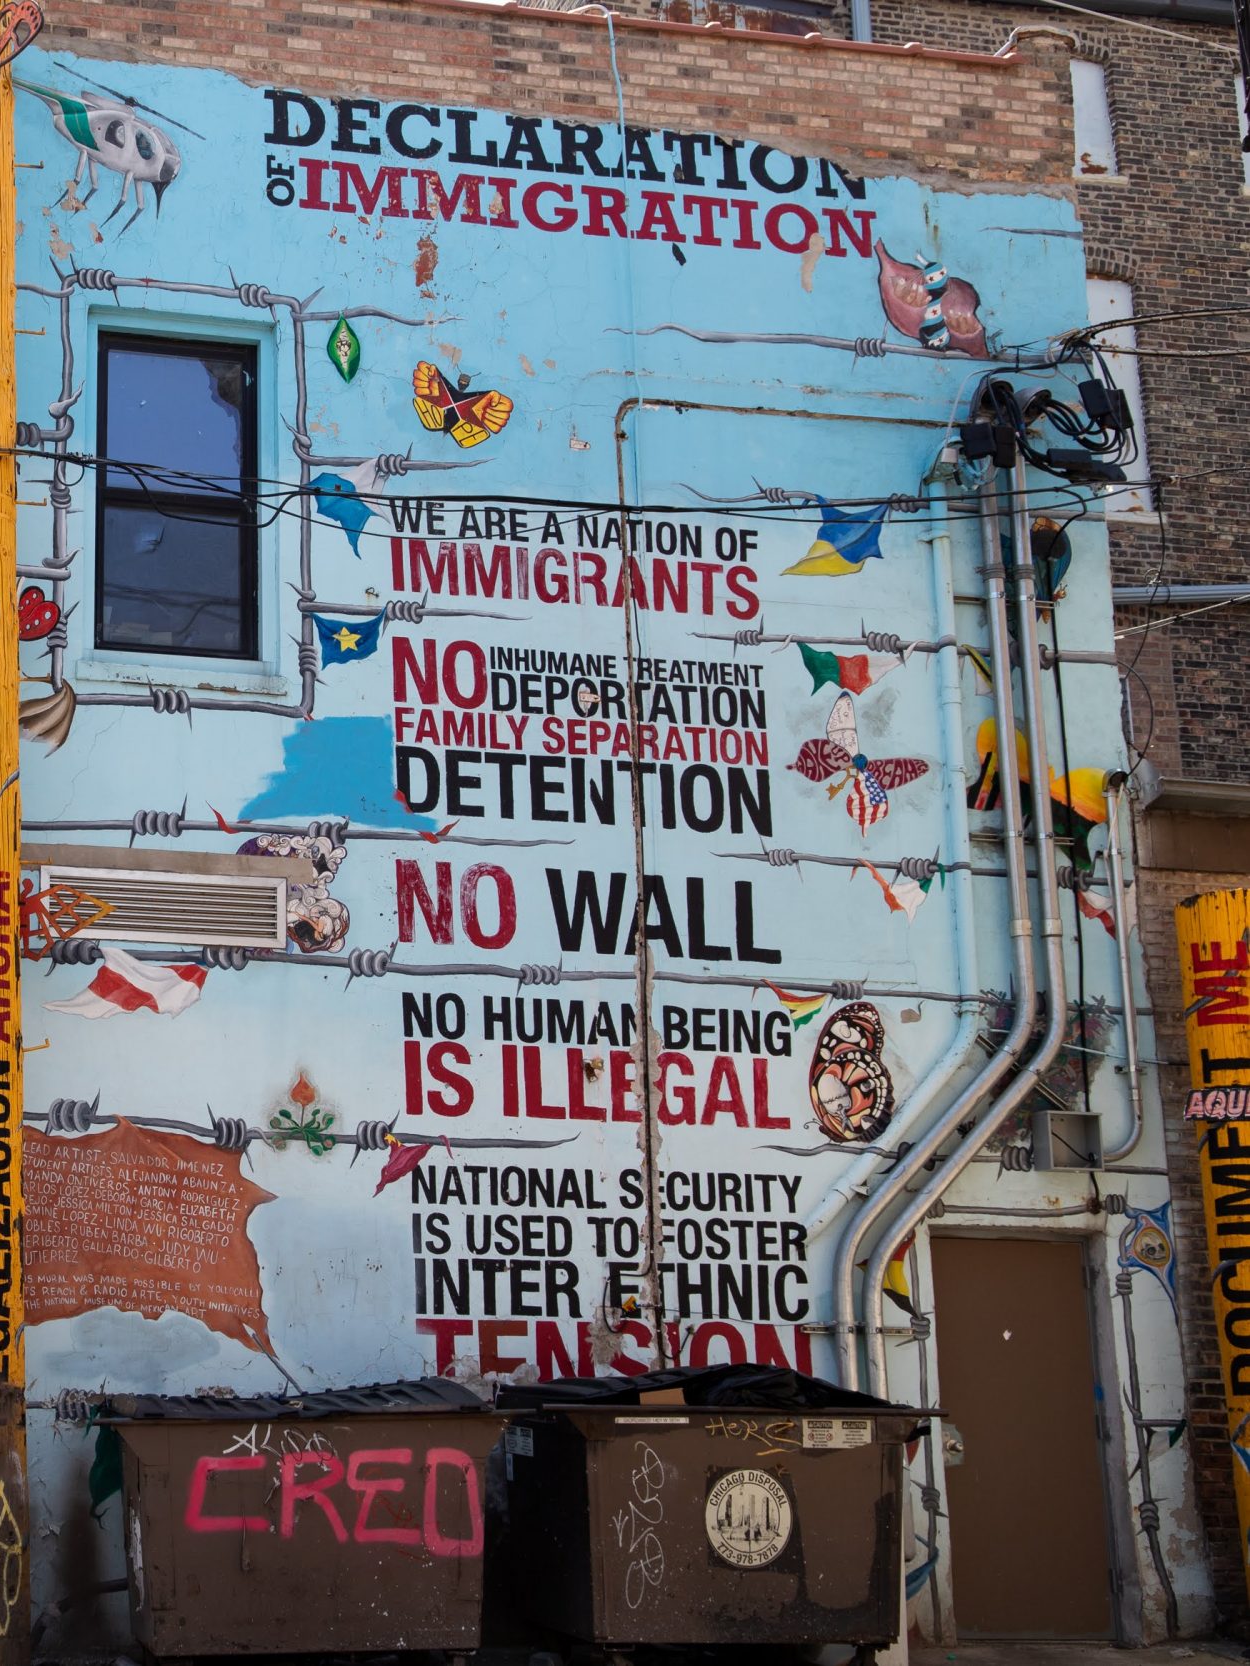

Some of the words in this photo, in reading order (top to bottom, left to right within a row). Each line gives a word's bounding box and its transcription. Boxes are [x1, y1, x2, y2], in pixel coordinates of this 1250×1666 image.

[264, 89, 867, 199] DECLARATION
[266, 155, 295, 206] OF
[299, 157, 877, 258] IMMIGRATION
[391, 499, 446, 535] WE
[459, 506, 529, 543] ARE
[541, 512, 565, 544] A
[578, 515, 703, 557] NATION
[715, 530, 759, 562] OF
[391, 538, 760, 620] IMMIGRANTS
[392, 636, 488, 709] NO
[490, 647, 616, 679] INHUMANE
[624, 656, 763, 687] TREATMENT
[491, 672, 766, 729] DEPORTATION
[394, 707, 529, 750] FAMILY
[543, 716, 769, 766] SEPARATION
[396, 745, 772, 837] DETENTION
[396, 858, 516, 949] NO
[545, 868, 782, 964] WALL
[402, 992, 466, 1039] NO
[483, 995, 638, 1048] HUMAN
[663, 1006, 792, 1057] BEING
[404, 1041, 474, 1117] IS
[502, 1044, 791, 1130] ILLEGAL
[22, 1154, 68, 1170] STUDENT
[118, 1169, 178, 1186] ALEJANDRA
[183, 1177, 236, 1194] ABAUNZA
[23, 1142, 50, 1156] LEAD
[109, 1151, 170, 1169] SALVADOR
[173, 1159, 224, 1177] JIMENEZ
[60, 1185, 89, 1198] LOPEZ
[95, 1189, 137, 1205] DEBORAH
[140, 1197, 174, 1211] GARCIA
[180, 1203, 236, 1221] ELIZABETH
[67, 1174, 130, 1195] ONTIVEROS
[138, 1185, 177, 1198] ANTONY
[181, 1190, 241, 1211] RODRIGUEZ
[412, 1164, 606, 1210] NATIONAL
[54, 1196, 93, 1211] JESSICA
[95, 1201, 132, 1216] MILTON
[137, 1209, 177, 1224] JESSICA
[181, 1216, 234, 1234] SALGADO
[62, 1210, 98, 1226] LOPEZ
[105, 1216, 138, 1232] LINDA
[143, 1223, 162, 1237] WU
[168, 1226, 230, 1247] RIGOBERTO
[412, 1212, 451, 1256] IS
[465, 1213, 573, 1258] USED
[587, 1216, 640, 1258] TO
[657, 1217, 808, 1261] FOSTER
[70, 1224, 109, 1240] RUBEN
[112, 1230, 148, 1247] BARBA
[158, 1240, 191, 1257] JUDY
[195, 1247, 219, 1265] WU
[82, 1239, 139, 1259] GALLARDO
[144, 1250, 202, 1274] GILBERTO
[37, 1274, 68, 1283] MURAL
[72, 1274, 95, 1283] WAS
[100, 1276, 127, 1286] MADE
[133, 1279, 181, 1291] POSSIBLE
[42, 1286, 75, 1296] REACH
[79, 1284, 88, 1296] &
[94, 1284, 128, 1298] RADIO
[172, 1295, 206, 1307] YOUTH
[209, 1301, 260, 1319] INITIATIVES
[414, 1258, 583, 1319] INTER
[608, 1262, 810, 1322] ETHNIC
[44, 1297, 78, 1307] NATIONAL
[125, 1301, 135, 1310] OF
[185, 1307, 207, 1319] ART
[709, 1472, 745, 1507] CHICAGO
[748, 1472, 788, 1509] DISPOSAL
[717, 1541, 779, 1564] 773-978-7878
